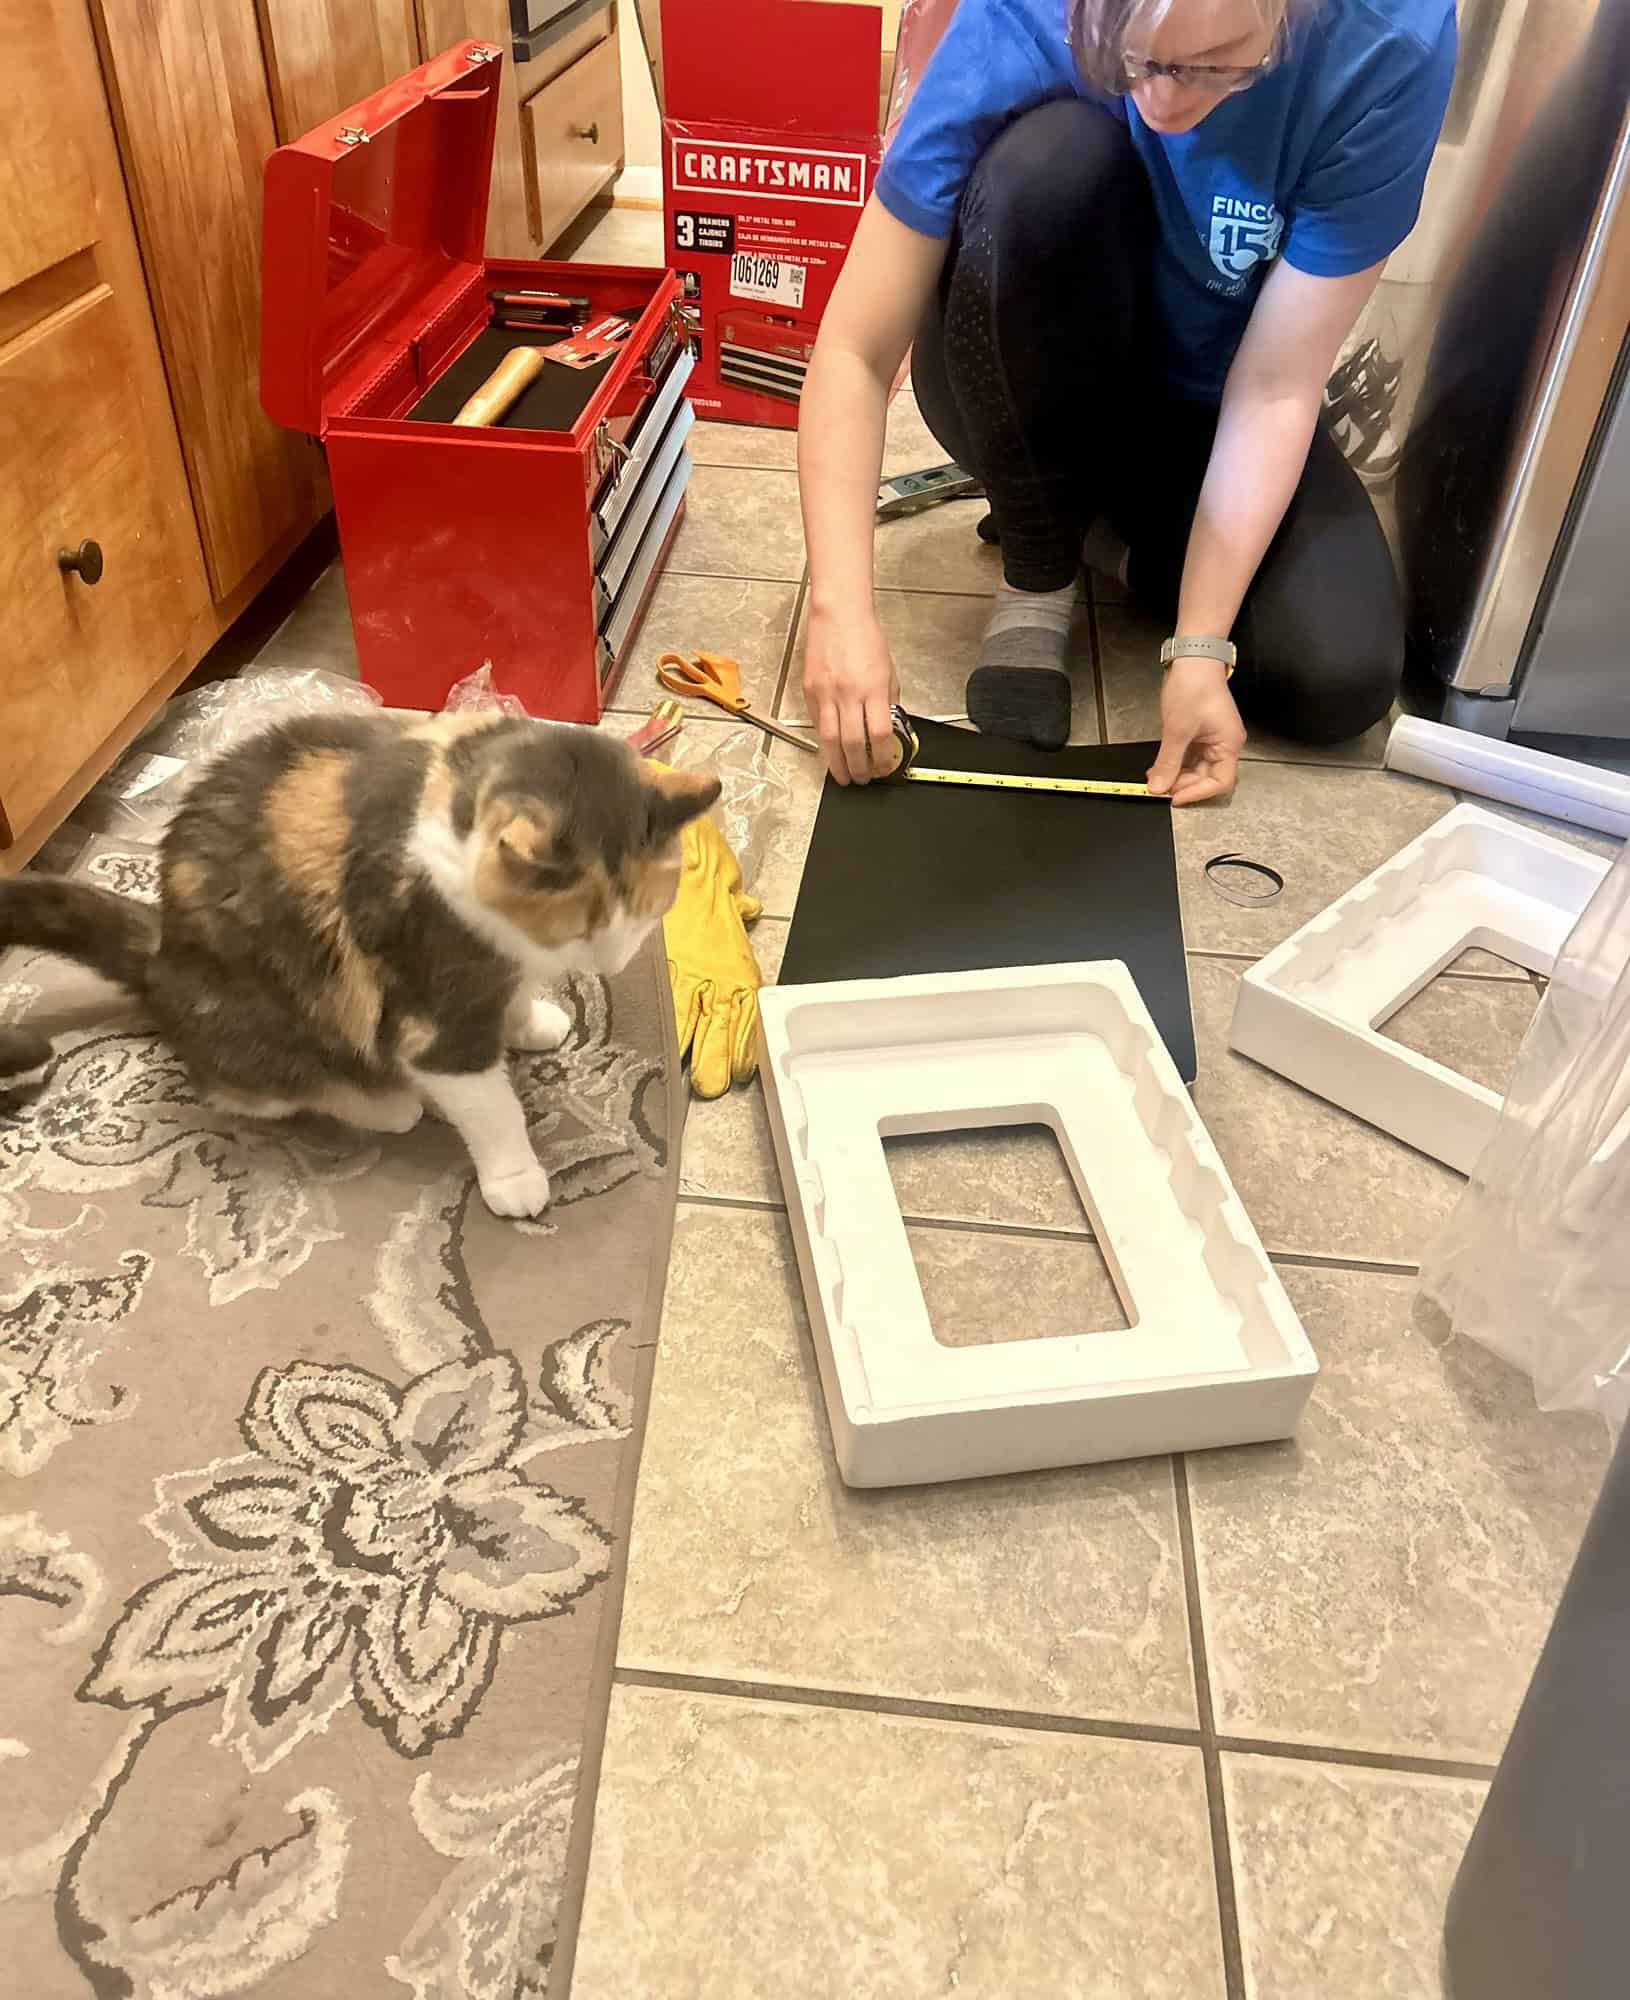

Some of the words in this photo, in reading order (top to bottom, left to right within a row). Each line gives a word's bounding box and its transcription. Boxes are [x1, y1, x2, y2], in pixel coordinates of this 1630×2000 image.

[684, 152, 851, 193] CRAFTSMAN
[677, 215, 694, 247] 3
[698, 216, 730, 227] DRAWERS
[698, 228, 727, 238] CAJONES
[732, 255, 780, 289] 1061269
